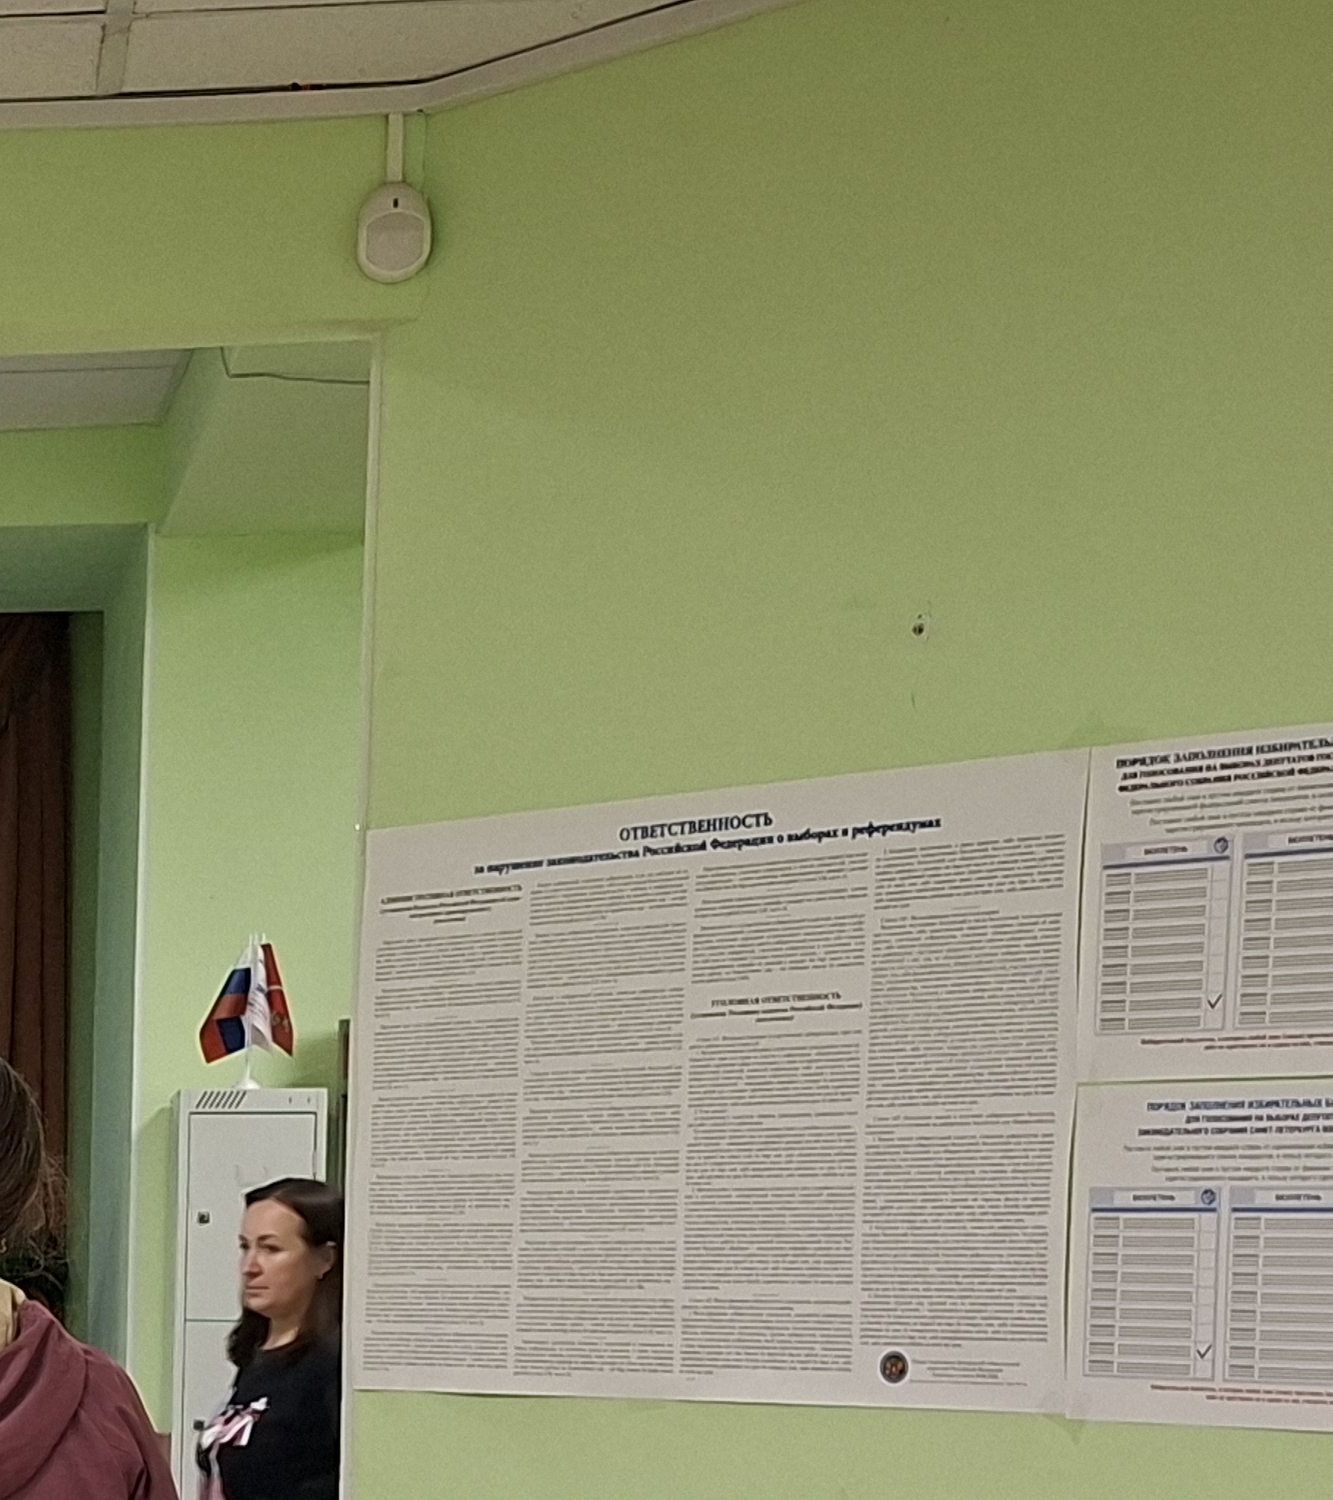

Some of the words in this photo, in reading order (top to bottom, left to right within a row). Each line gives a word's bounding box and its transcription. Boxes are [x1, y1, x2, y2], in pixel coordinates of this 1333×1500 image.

[619, 811, 773, 842] ОТВЕТСТВЕННОСТЬ
[787, 828, 839, 844] выборах
[851, 817, 941, 840] референдумах
